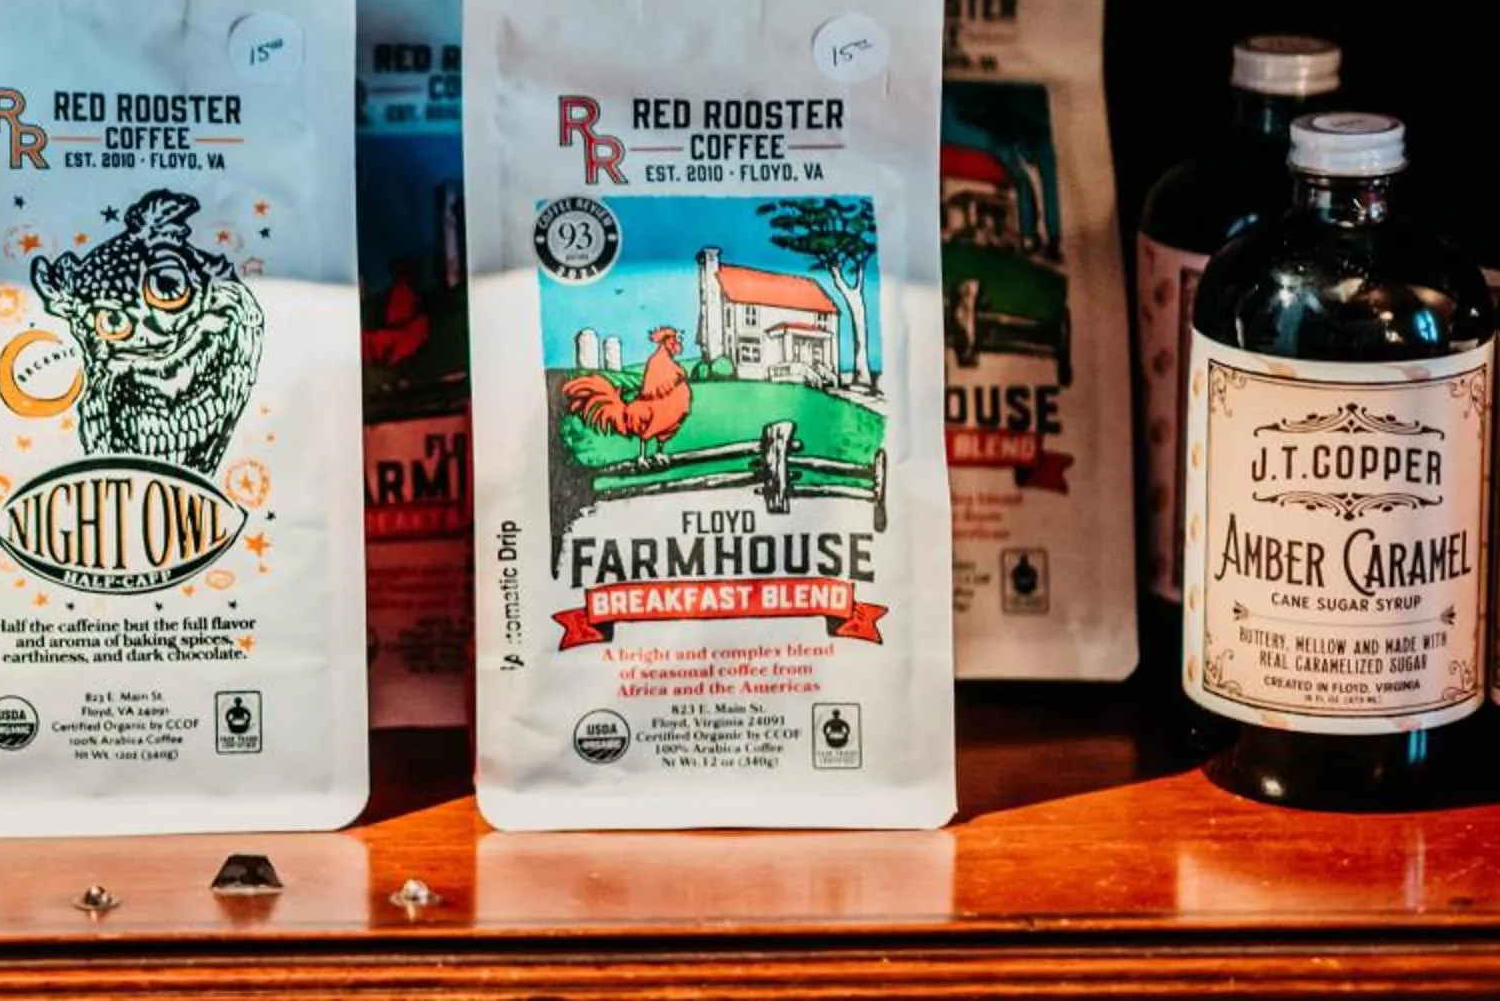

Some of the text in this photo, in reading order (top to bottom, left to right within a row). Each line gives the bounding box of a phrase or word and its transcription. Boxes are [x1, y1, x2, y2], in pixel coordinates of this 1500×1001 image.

[53, 91, 241, 125] RED ROOSTER
[632, 98, 844, 130] RED ROOSTER
[105, 126, 190, 150] COFFEE
[690, 134, 785, 161] COFFEE
[65, 152, 225, 170] EST. 2010 FLOYD, VA
[645, 164, 824, 183] EST. 2010 FLOYD, VA
[559, 222, 593, 249] 93
[7, 478, 227, 570] NIGHT OWL
[682, 510, 756, 535] FLOYD
[497, 520, 522, 561] Drip
[571, 532, 875, 589] FARMHOUSE
[1214, 513, 1472, 597] AMBER CARAMEL
[592, 583, 848, 616] BREAKFAST BLEND
[1271, 592, 1421, 611] CANE SUGAR SYRUP
[29, 619, 54, 633] the
[58, 618, 120, 633] caffeine
[124, 618, 149, 633] but
[153, 618, 179, 632] the
[182, 617, 208, 631] full
[211, 617, 257, 631] flavor
[15, 634, 47, 648] and
[49, 636, 101, 648] aroma
[104, 633, 122, 647] of
[122, 633, 178, 651] baking
[601, 643, 834, 664] A bright and complex blend
[1295, 635, 1347, 656] MELLOW
[1353, 638, 1380, 657] AND
[1385, 635, 1419, 654] MADE
[93, 649, 124, 663] and
[126, 648, 163, 662] dark
[1258, 649, 1426, 674] REAL CARAMELIZED SUGAR
[620, 663, 813, 680] of seasonal coffee from
[1263, 675, 1312, 691] CREATED
[1316, 678, 1328, 691] IN
[1375, 679, 1420, 691] VIRGINIA
[617, 680, 820, 697] Africa and the Americas
